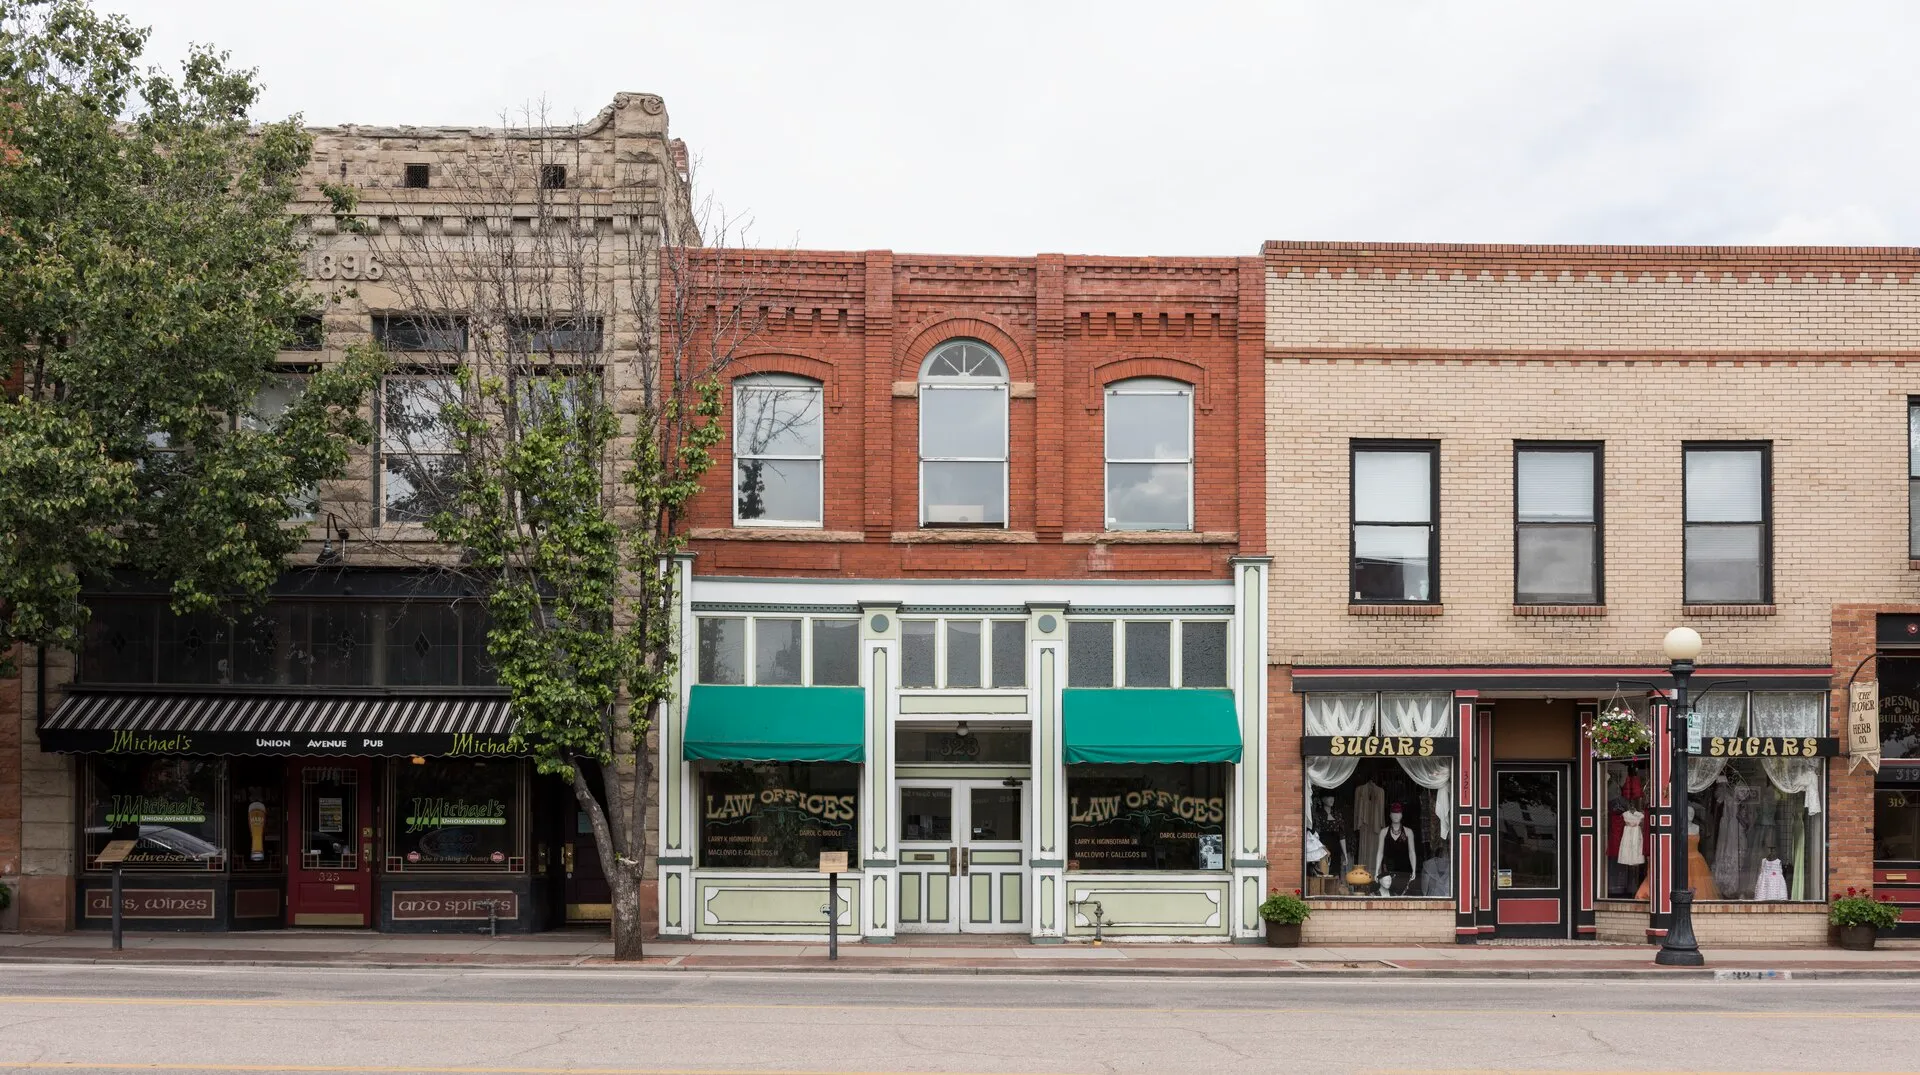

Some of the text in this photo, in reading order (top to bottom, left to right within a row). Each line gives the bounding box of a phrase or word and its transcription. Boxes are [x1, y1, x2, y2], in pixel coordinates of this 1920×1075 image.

[305, 251, 384, 281] 1896
[1858, 691, 1871, 699] THE
[1851, 700, 1875, 712] FLOWER
[1879, 695, 1919, 714] FRESNO
[1879, 714, 1920, 724] BUILDING
[1852, 723, 1871, 734] HERB
[444, 733, 530, 756] JMichaels
[940, 737, 980, 757] 323
[1330, 735, 1434, 756] SUGARS
[1709, 736, 1818, 757] SUGARS
[1895, 768, 1920, 781] 319
[706, 788, 855, 820] LAW OFFICES
[1070, 789, 1224, 822] LAW OFFICES
[1888, 797, 1905, 808] 319
[318, 872, 340, 881] 325
[93, 895, 139, 910] als,
[145, 898, 207, 910] wines
[399, 900, 440, 911] and
